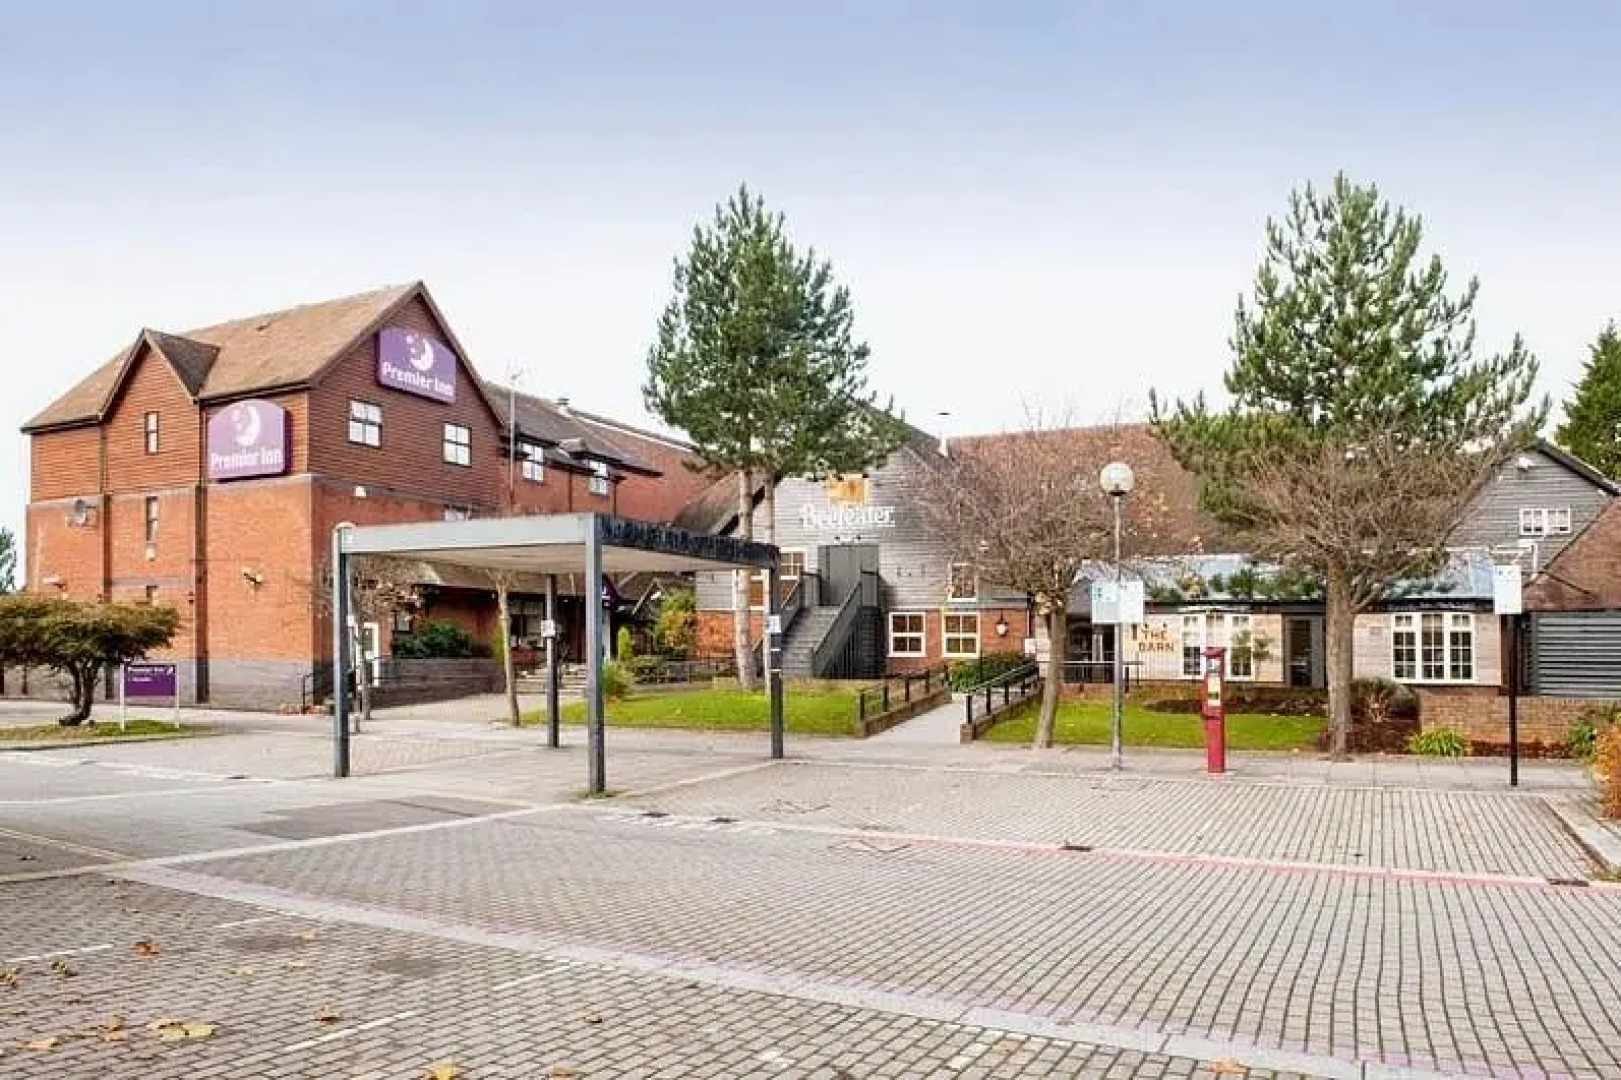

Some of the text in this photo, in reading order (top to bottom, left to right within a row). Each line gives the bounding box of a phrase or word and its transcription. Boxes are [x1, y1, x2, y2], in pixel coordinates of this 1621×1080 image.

[381, 361, 454, 396] Premier Inn
[210, 446, 284, 471] Premier Inn
[1140, 629, 1168, 640] THE
